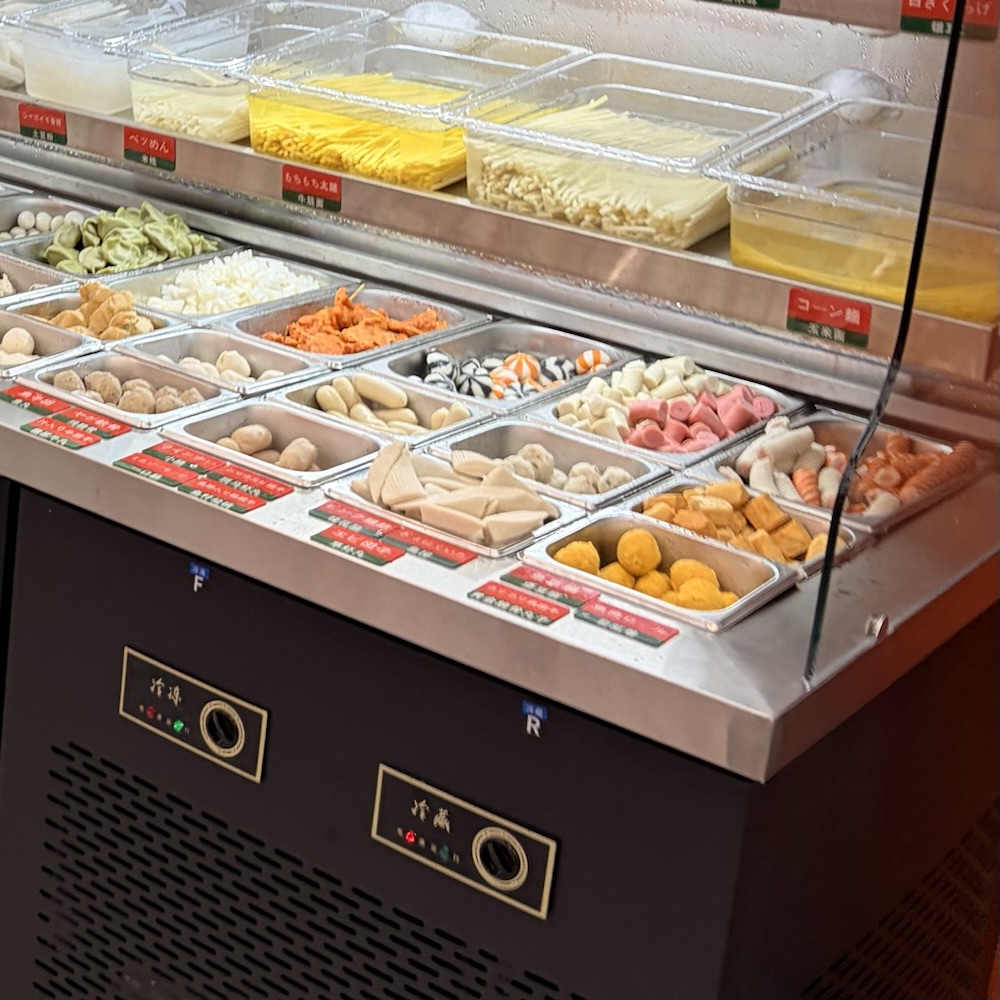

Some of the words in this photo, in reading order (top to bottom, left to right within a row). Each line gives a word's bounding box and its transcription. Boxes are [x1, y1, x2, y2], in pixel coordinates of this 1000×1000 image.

[285, 171, 338, 194] もちもち太麺
[797, 297, 861, 325] コーン麺
[193, 574, 204, 593] F
[526, 714, 541, 738] R
